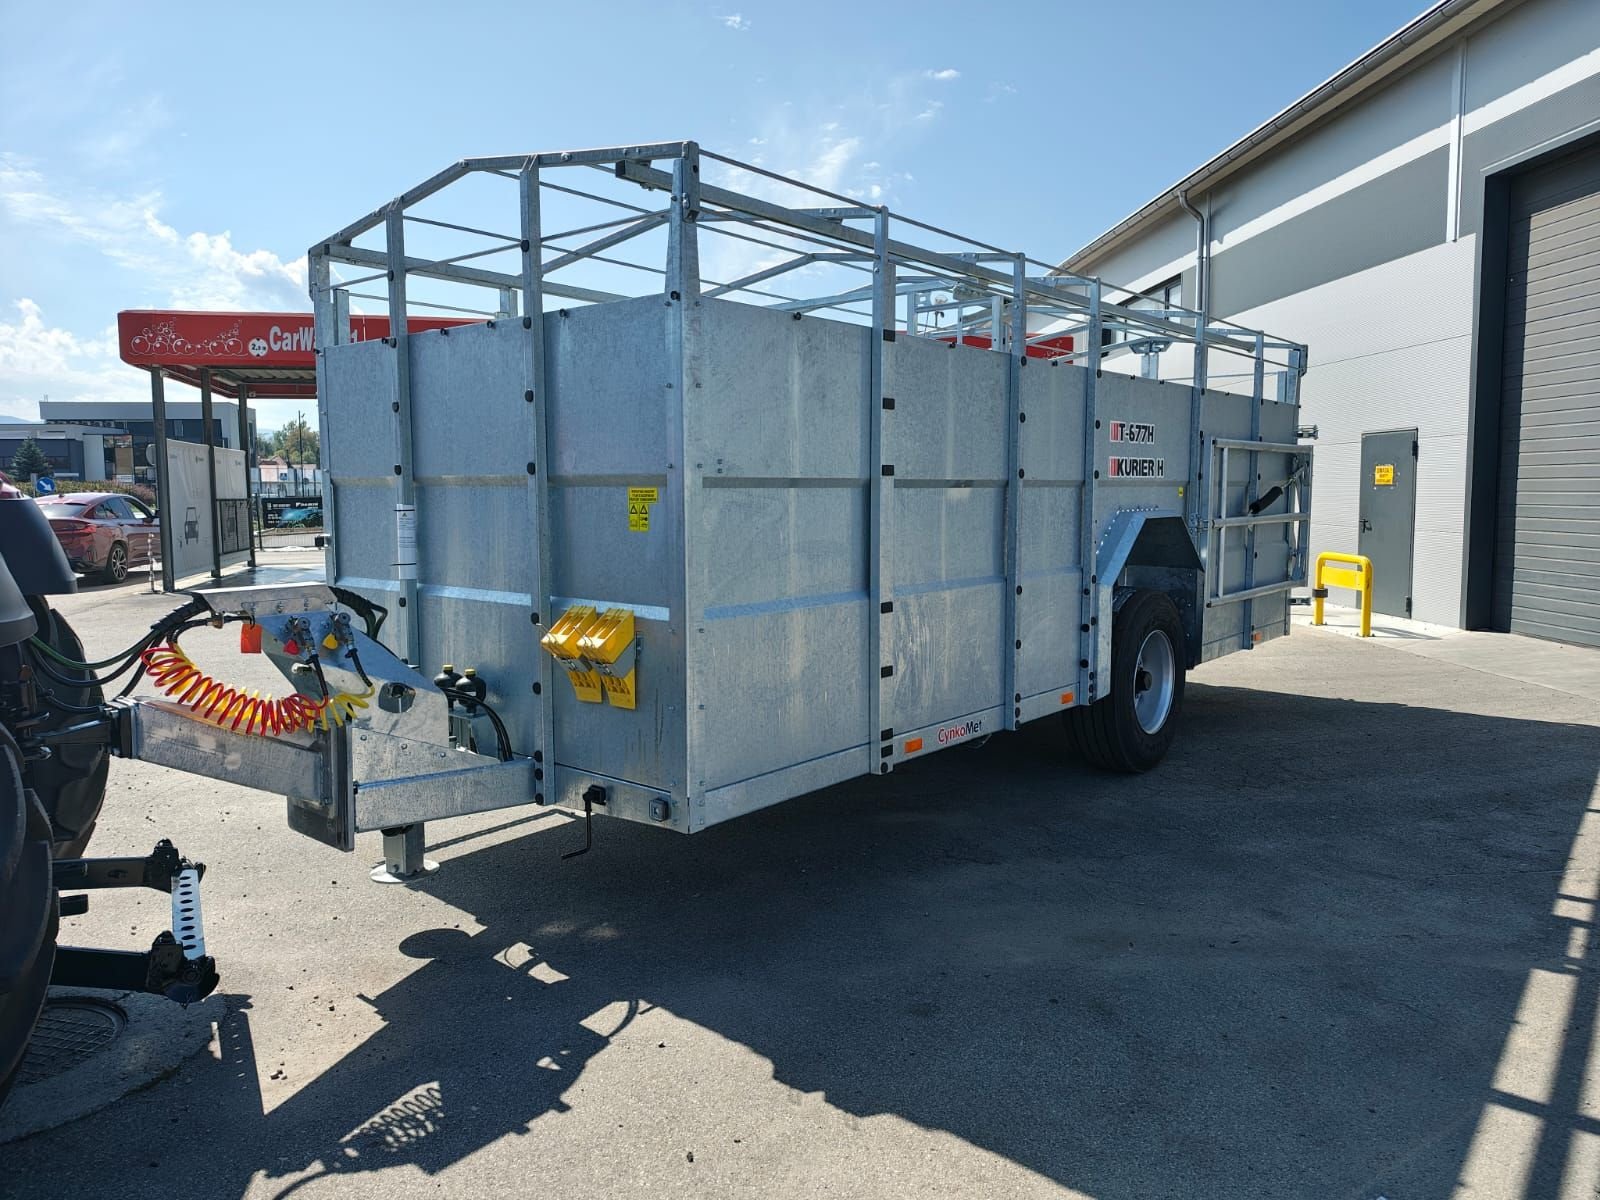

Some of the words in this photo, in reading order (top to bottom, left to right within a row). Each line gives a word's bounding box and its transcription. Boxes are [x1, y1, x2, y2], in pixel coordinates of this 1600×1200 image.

[269, 325, 315, 351] CarW
[1119, 423, 1154, 443] T-677H
[1116, 458, 1155, 476] KURIER
[1157, 459, 1164, 476] H
[938, 719, 982, 744] CynkoMet
